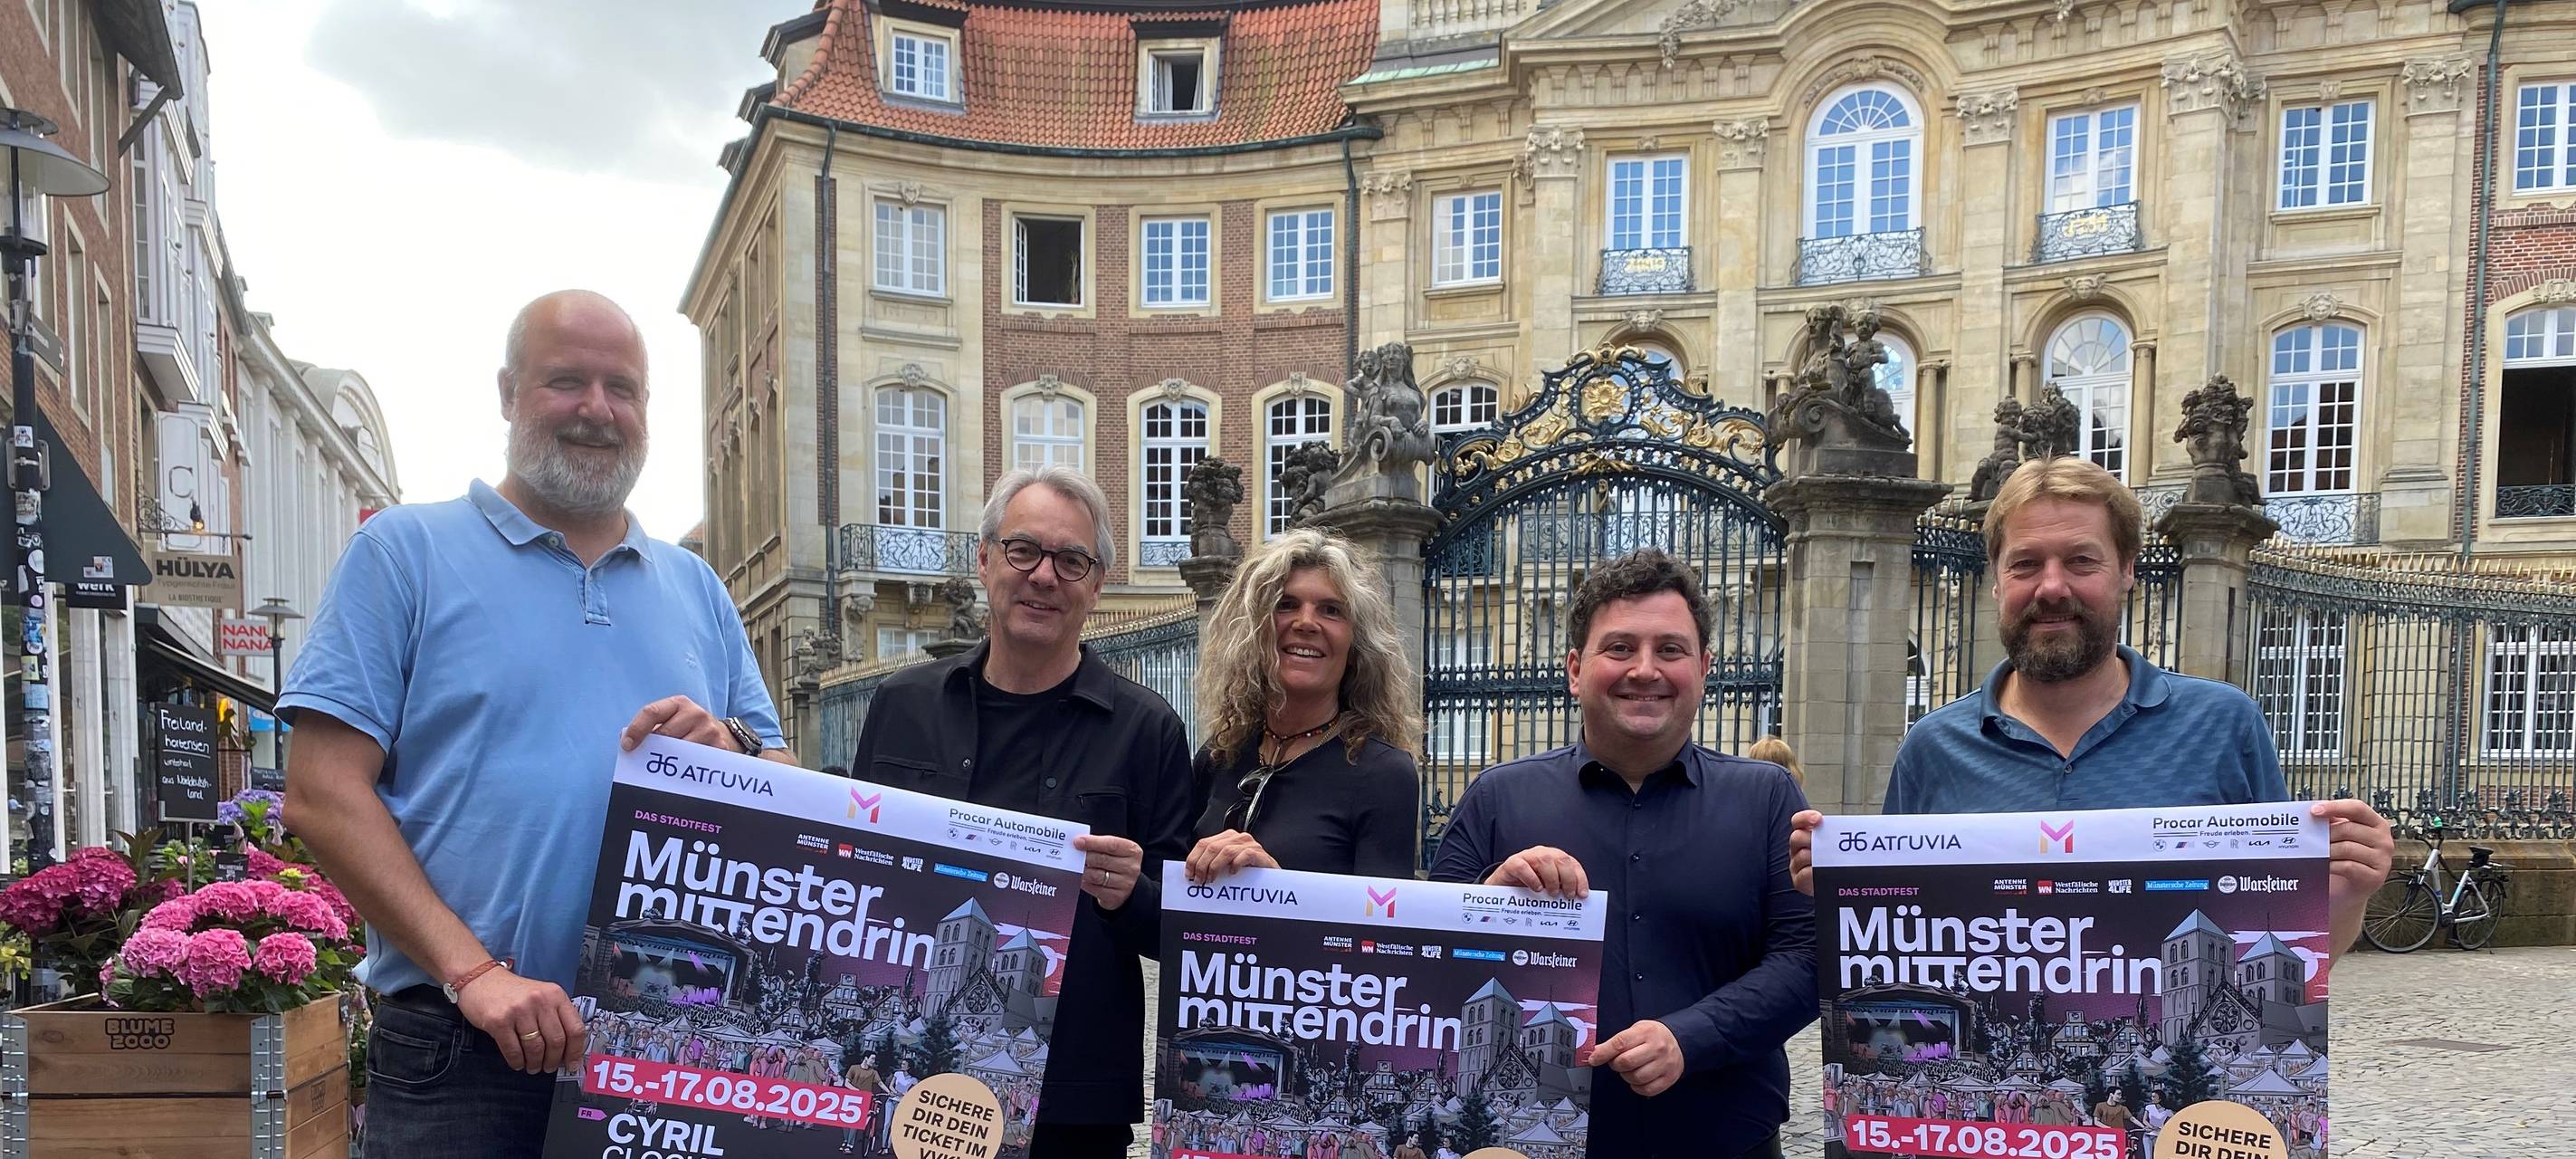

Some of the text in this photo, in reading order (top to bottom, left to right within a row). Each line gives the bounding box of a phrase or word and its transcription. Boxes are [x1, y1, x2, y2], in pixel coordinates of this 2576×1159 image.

[156, 557, 235, 580] HÜLYA
[634, 809, 722, 834] DAS STADTFEST
[949, 808, 1066, 840] Procar Automobile
[2153, 813, 2299, 829] Procar Automobile
[797, 834, 830, 844] ANTENNE
[987, 829, 1006, 837] Freude
[797, 838, 828, 850] MÜNSTER
[838, 848, 852, 857] WN
[854, 848, 894, 861] Westfälische
[854, 854, 893, 867] Nachrichten
[624, 829, 884, 916] Münster
[1011, 875, 1057, 896] Warsteiner
[1838, 887, 1919, 896] DAS STADTFEST
[2108, 886, 2132, 894] 4LIFE
[2147, 881, 2208, 890] Münstersche Zeitung
[2239, 874, 2299, 894] Warsteiner
[1463, 893, 1582, 910] Procar Automobile
[615, 881, 936, 972] mittendrin
[1838, 905, 2094, 954] Münster
[1183, 932, 1257, 945] DAS STADTFEST
[1377, 943, 1414, 951] Westfälische
[1361, 945, 1374, 953] WN
[1377, 948, 1413, 956] Nachrichten
[1421, 951, 1441, 959] 4LIFE
[1531, 952, 1577, 968] Warsteiner
[1839, 943, 2162, 996] mittendrin
[1180, 950, 1407, 1008] Münster
[105, 1018, 175, 1035] BLUME
[1178, 996, 1462, 1053] mittendrin
[110, 1035, 170, 1049] 2000
[593, 1060, 864, 1124] 15.-17.08.2025
[580, 1109, 592, 1117] FR
[919, 1090, 994, 1122] SICHERE
[912, 1107, 988, 1139] DIR DEIN
[607, 1113, 724, 1156] CYRIL
[903, 1124, 987, 1158] TICKET IM
[1852, 1120, 2119, 1159] 15.-17.08.2025
[2179, 1122, 2272, 1149] SICHERE
[2175, 1141, 2212, 1159] DIR
